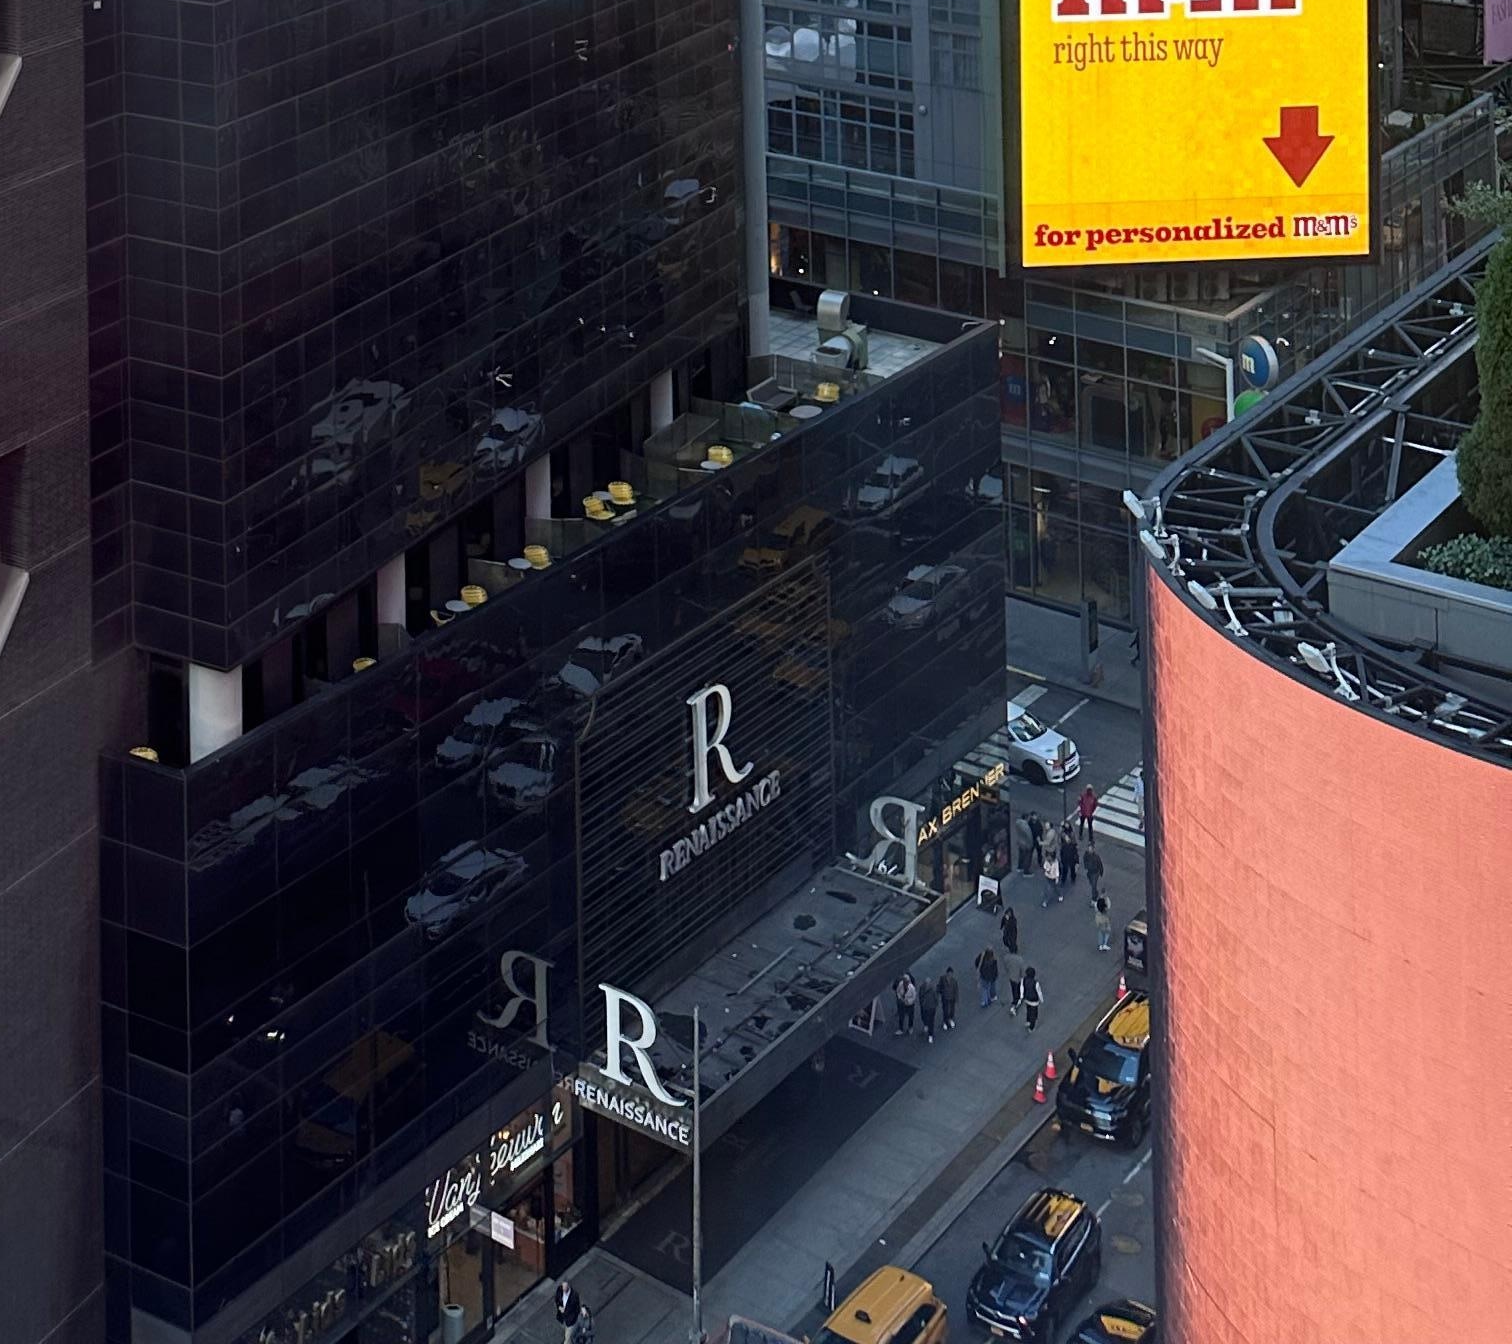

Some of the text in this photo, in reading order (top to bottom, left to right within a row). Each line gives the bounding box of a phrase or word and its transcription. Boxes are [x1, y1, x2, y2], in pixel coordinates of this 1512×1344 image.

[1053, 32, 1224, 71] right this way
[1034, 223, 1081, 248] for
[1085, 216, 1286, 252] personalized
[686, 683, 754, 814] R
[658, 769, 783, 882] RENAISSANCE
[917, 816, 939, 846] AX
[598, 982, 687, 1108] R
[573, 1079, 690, 1147] RENAISSANCE
